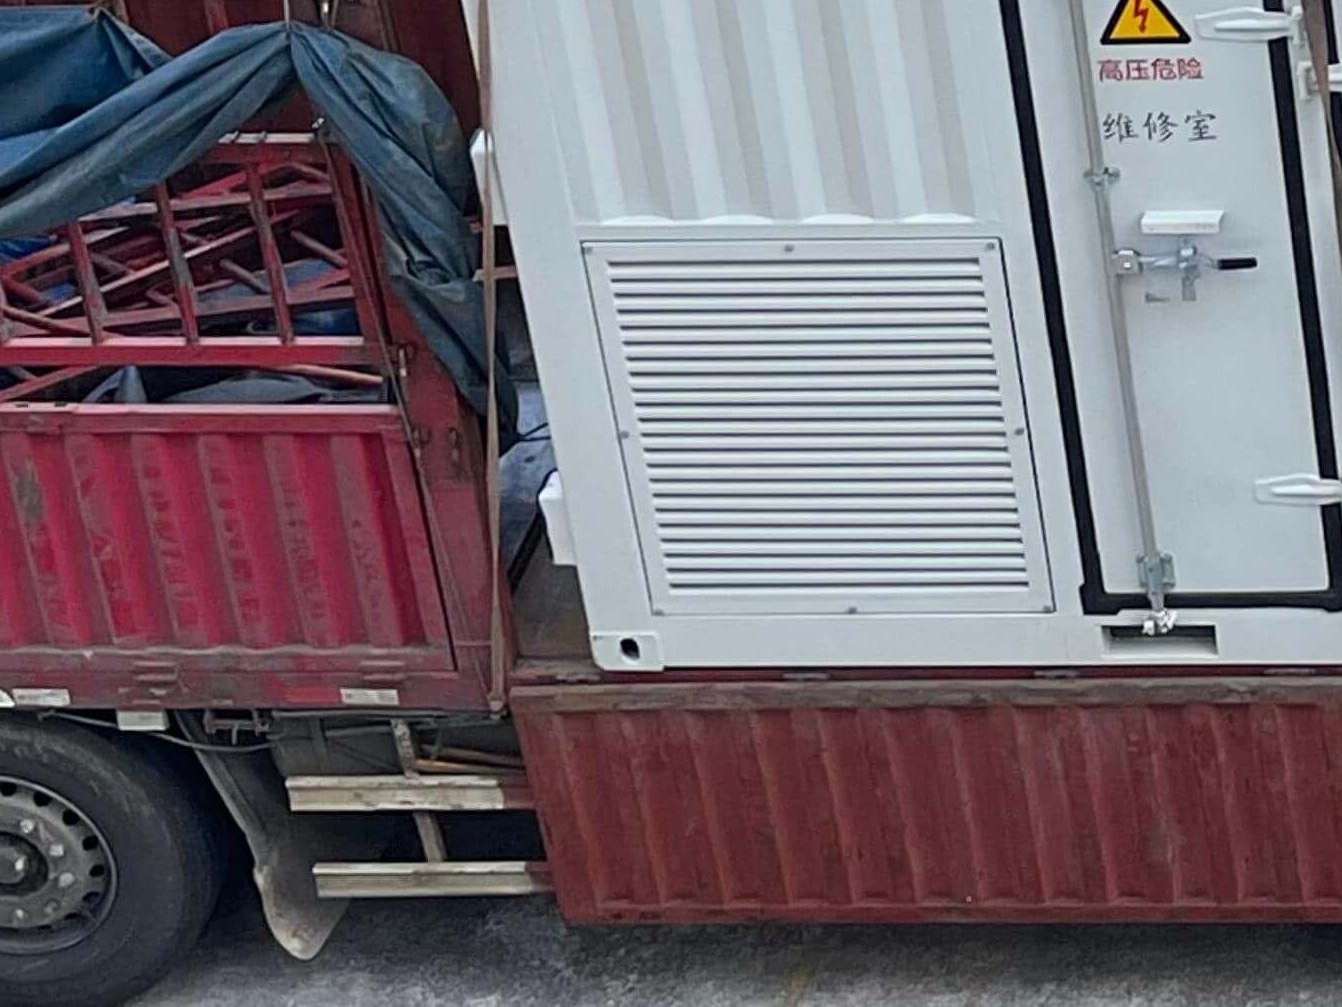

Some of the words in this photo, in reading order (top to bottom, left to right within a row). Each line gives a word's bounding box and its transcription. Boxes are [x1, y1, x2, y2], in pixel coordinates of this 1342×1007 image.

[1097, 57, 1204, 81] 高压危险
[1102, 109, 1217, 143] 维修室
